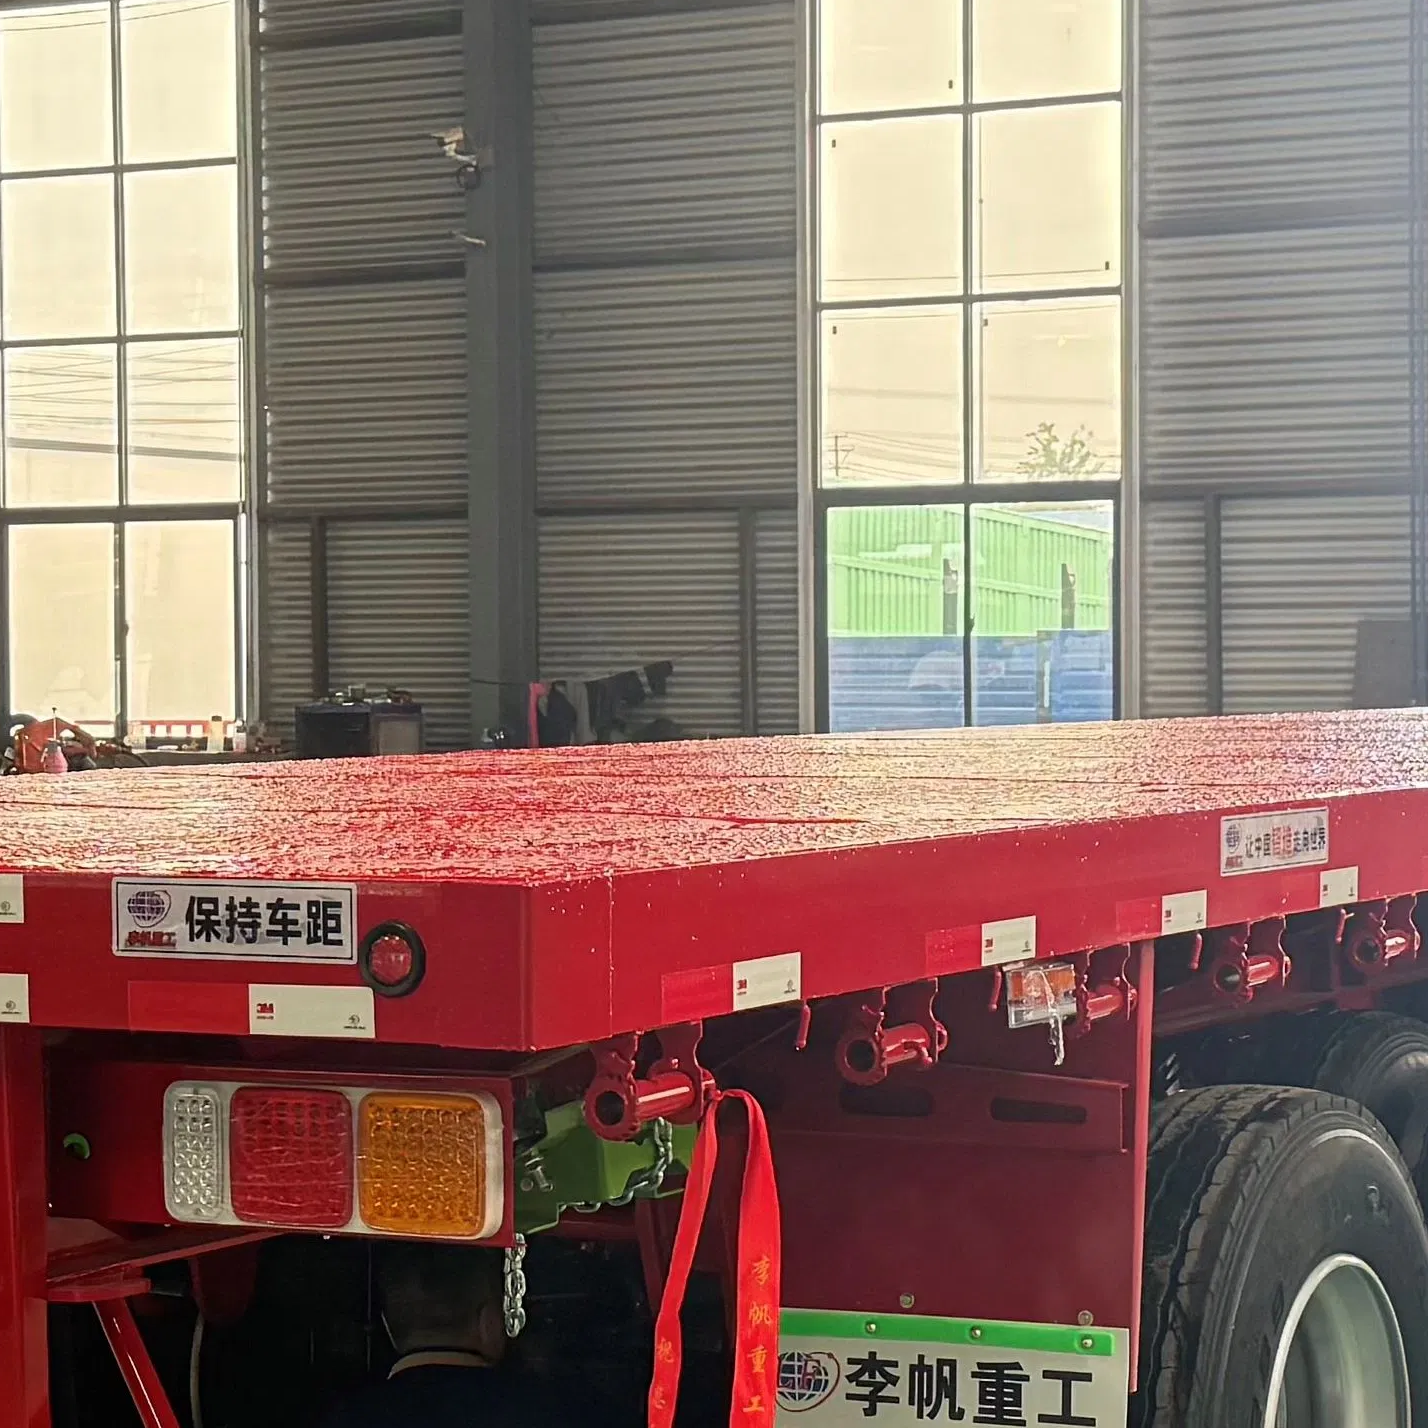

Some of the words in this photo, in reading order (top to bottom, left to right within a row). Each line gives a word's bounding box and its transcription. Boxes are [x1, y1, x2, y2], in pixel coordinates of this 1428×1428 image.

[184, 895, 344, 947] 保持车距
[256, 1003, 275, 1014] 3M
[743, 1256, 772, 1414] 李帆重工
[844, 1350, 1097, 1428] 李帆重工
